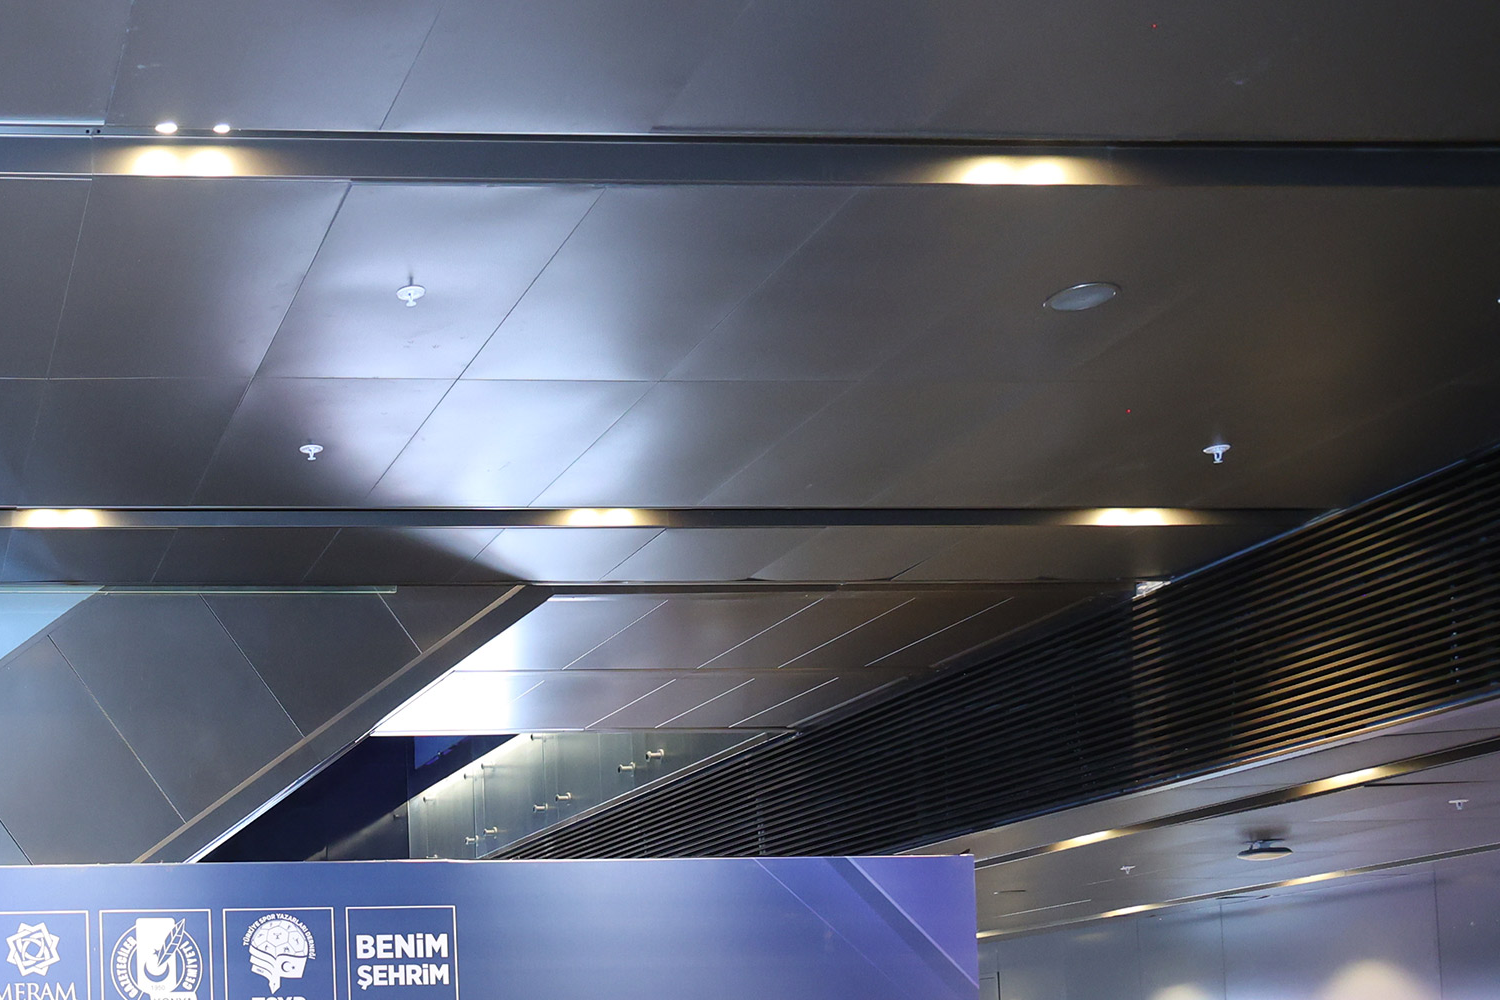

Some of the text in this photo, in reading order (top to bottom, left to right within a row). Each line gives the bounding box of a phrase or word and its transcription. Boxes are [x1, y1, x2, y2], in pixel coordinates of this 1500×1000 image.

[242, 920, 260, 946] TÜRKİYE
[259, 913, 276, 924] SPOR
[276, 913, 308, 933] YAZARLARI
[116, 935, 138, 999] GAZETECİLER
[179, 940, 198, 991] CEMİYETİ
